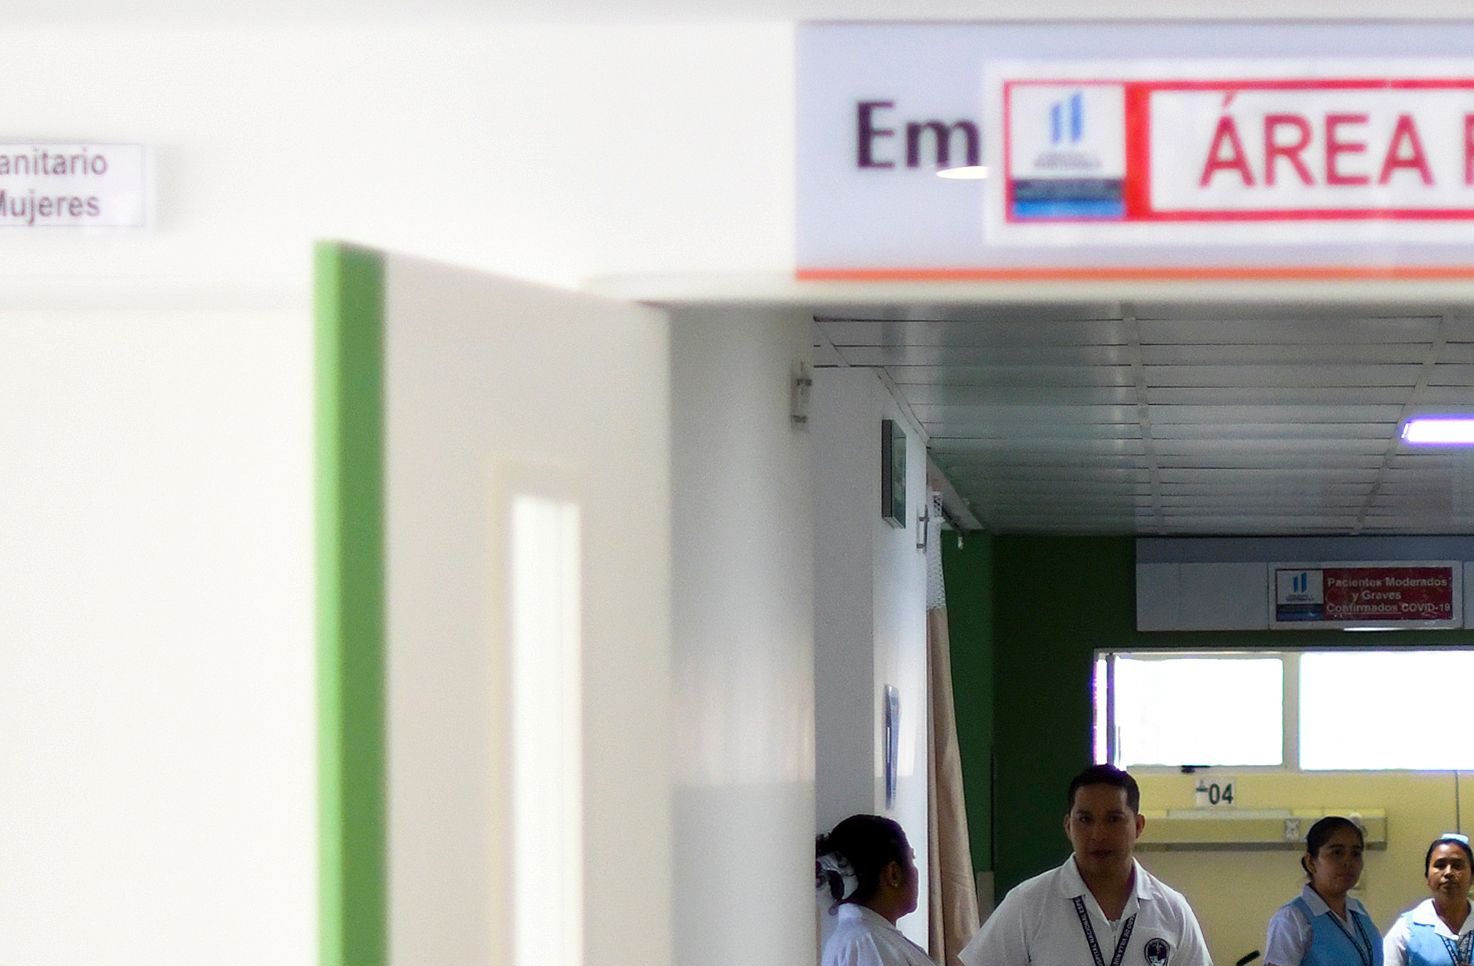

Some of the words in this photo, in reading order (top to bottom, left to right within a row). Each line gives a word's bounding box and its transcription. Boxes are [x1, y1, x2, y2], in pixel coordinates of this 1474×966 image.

[1198, 91, 1434, 187] ÁREA
[1327, 577, 1382, 588] Pacientes
[1385, 576, 1448, 587] Moderados
[1352, 592, 1359, 602] y
[1361, 590, 1402, 600] Graves
[1326, 602, 1399, 613] Confirmados
[1401, 603, 1451, 613] COVID-19
